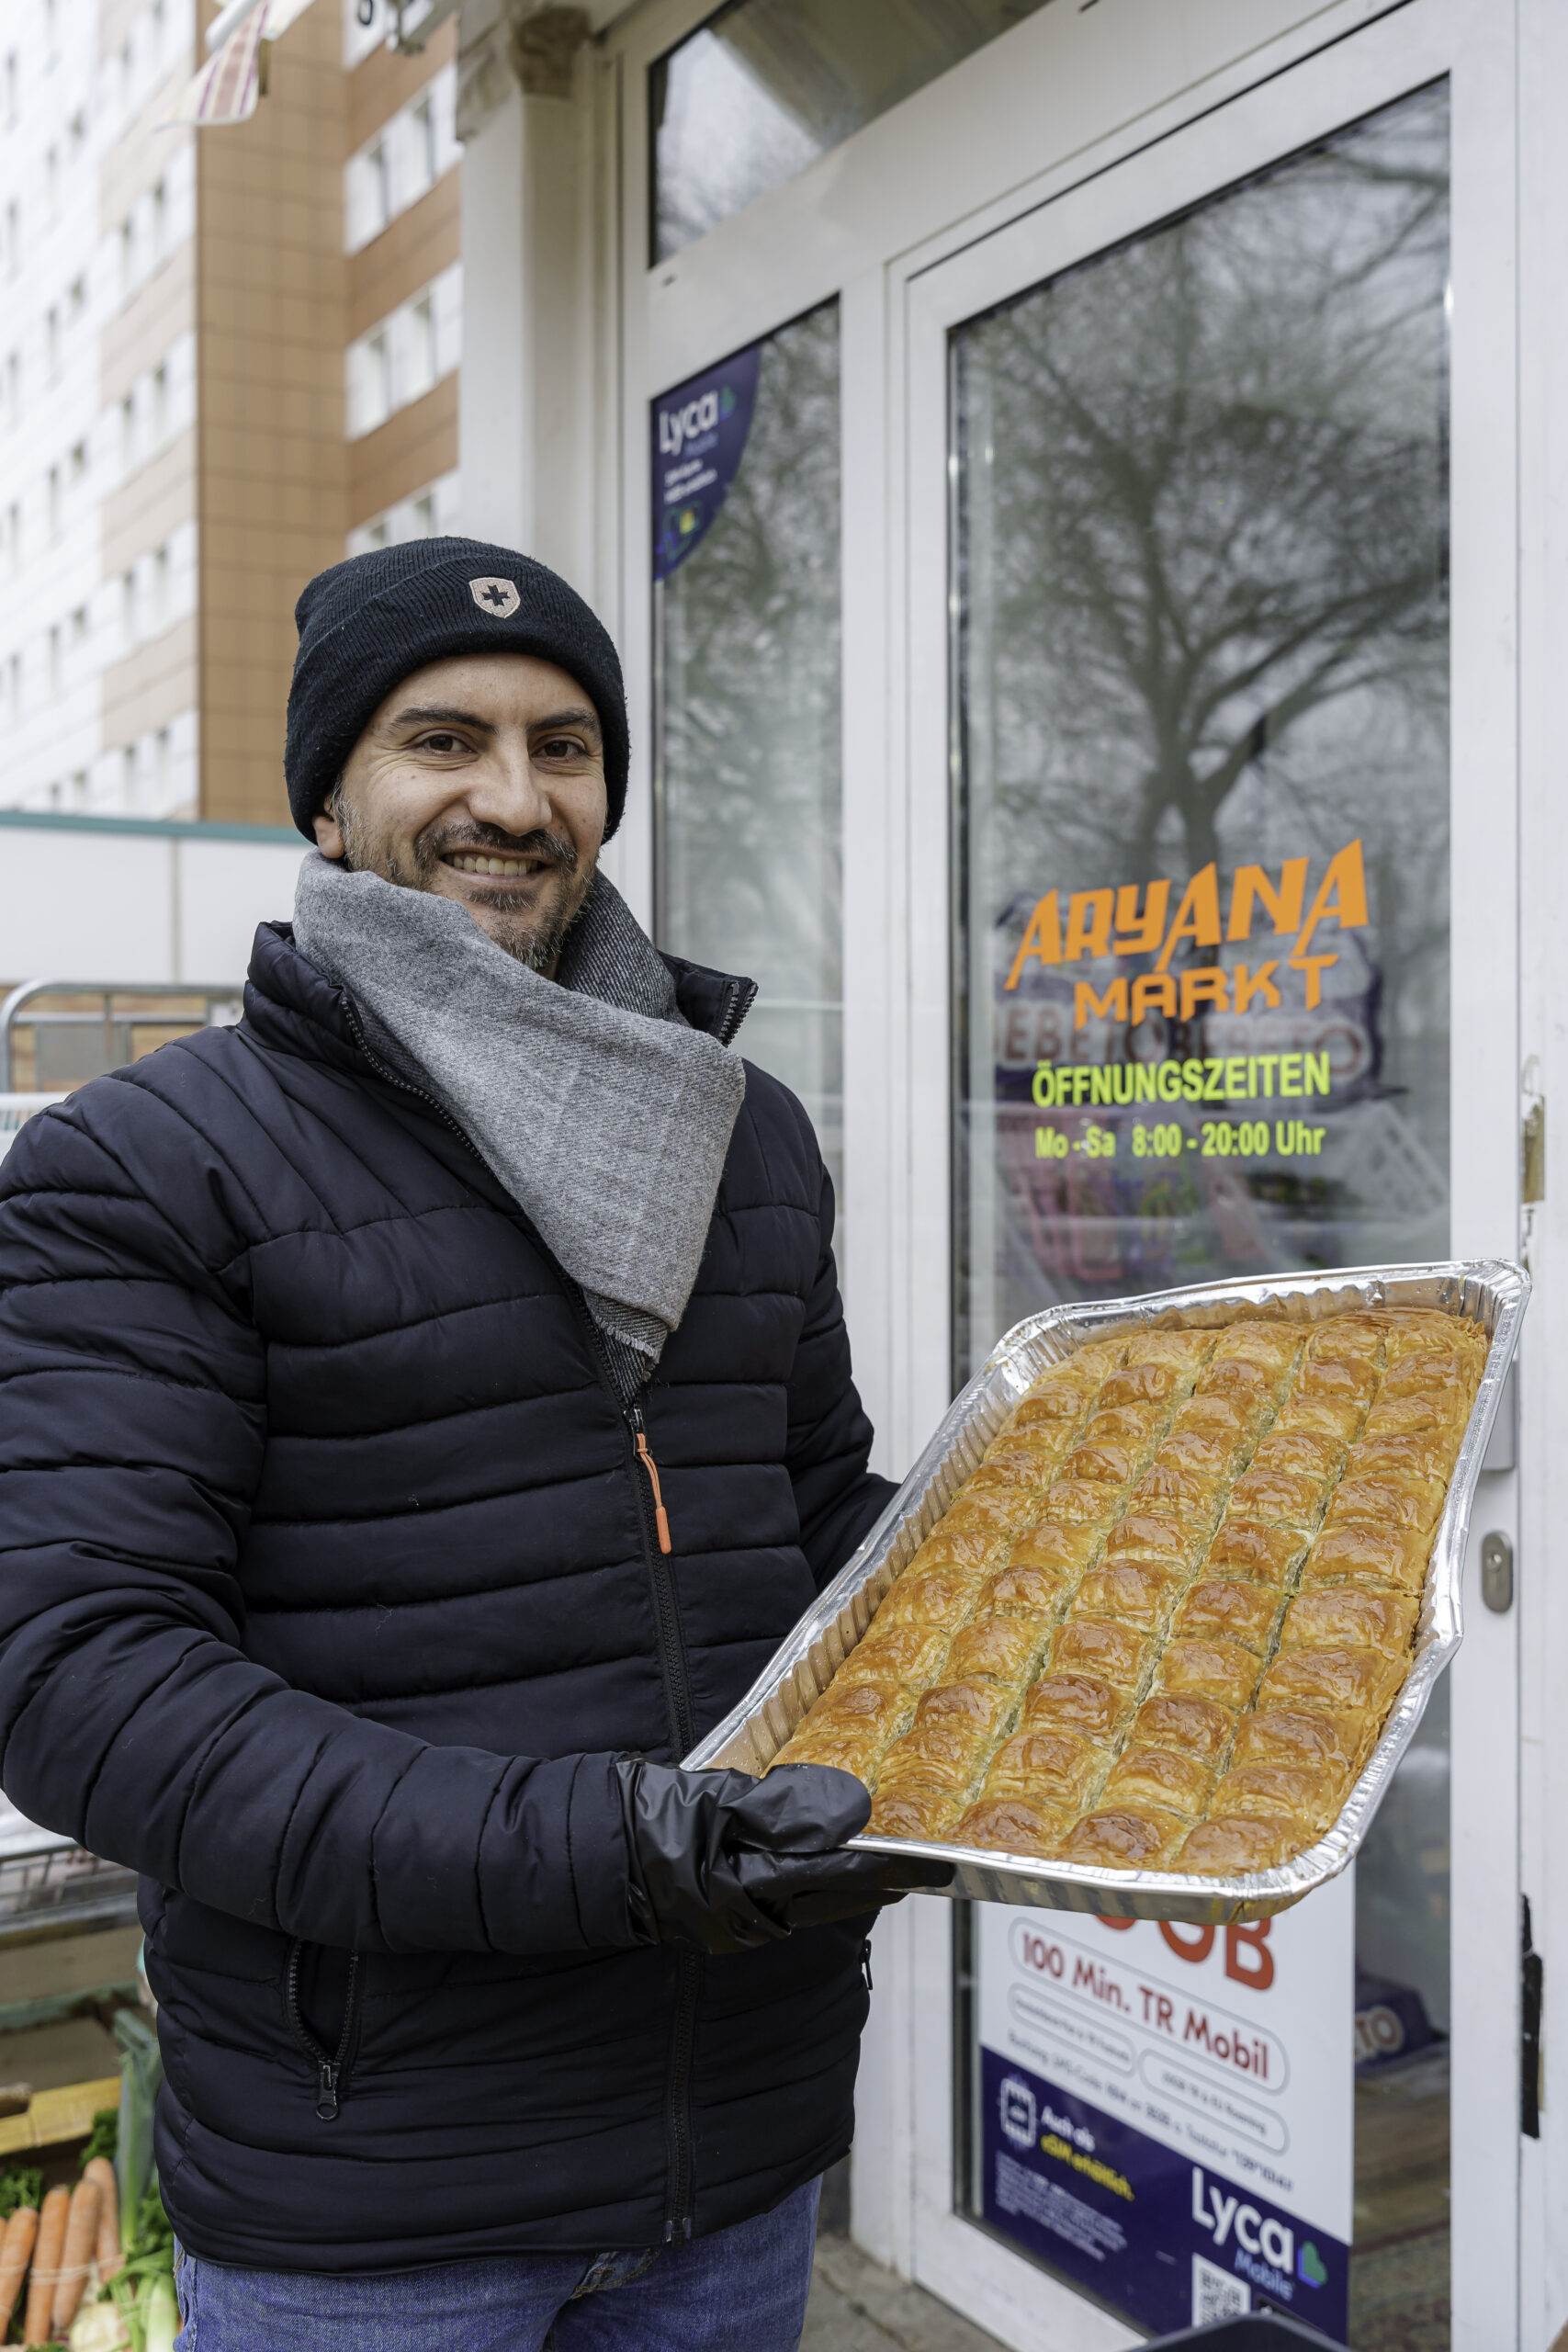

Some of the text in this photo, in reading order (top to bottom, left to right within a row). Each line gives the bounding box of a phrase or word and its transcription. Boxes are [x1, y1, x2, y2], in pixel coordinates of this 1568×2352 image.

[660, 390, 718, 456] Lyca
[1004, 837, 1369, 990] ARYANA
[1075, 953, 1338, 1030] MARKT
[1032, 1051, 1330, 1107] ÖFFNUNGSZEITEN
[1035, 1126, 1068, 1159] Mo
[1132, 1123, 1182, 1158] 8:00
[1201, 1121, 1270, 1157] 20:00
[1275, 1120, 1325, 1155] Uhr
[1021, 1931, 1065, 1979] 100
[1073, 1960, 1131, 2013] Min.
[1138, 1984, 1173, 2034] TR
[1183, 2015, 1269, 2080] Mobil
[1193, 2166, 1293, 2274] Lyca
